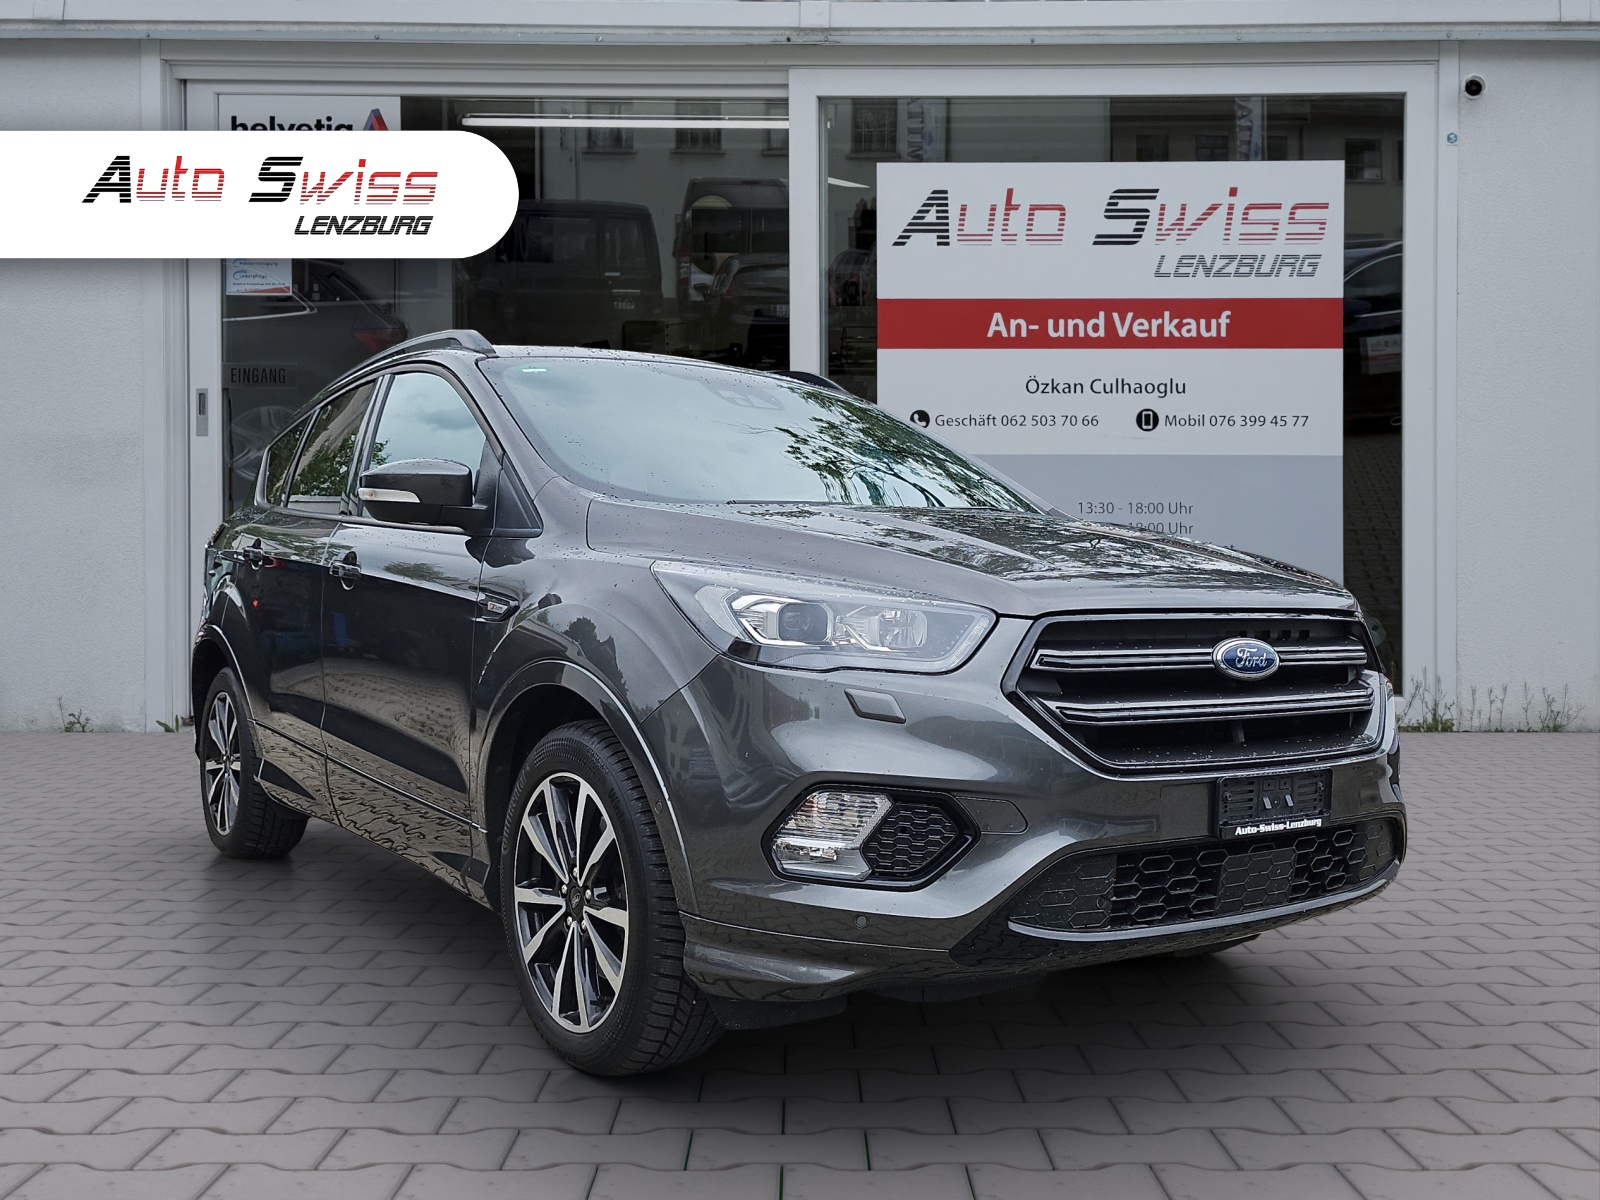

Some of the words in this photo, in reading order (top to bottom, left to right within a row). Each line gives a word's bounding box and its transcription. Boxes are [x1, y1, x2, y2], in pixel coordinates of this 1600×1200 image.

[891, 187, 1067, 246] Auto
[1092, 187, 1329, 246] Swiss
[1154, 254, 1322, 278] LENZBURG
[987, 312, 1040, 338] An-
[1047, 311, 1106, 338] und
[1112, 311, 1232, 338] Verkauf
[230, 367, 286, 384] EINGANG
[1025, 374, 1084, 395] Özkan
[1090, 375, 1186, 399] Culhaoglu
[935, 412, 998, 427] Geschäft
[1001, 413, 1027, 427] 062
[1031, 413, 1057, 427] 503
[1061, 413, 1078, 427] 70
[1082, 413, 1099, 427] 66
[1165, 413, 1206, 427] Mobil
[1209, 413, 1236, 427] 076
[1240, 413, 1267, 427] 399
[1270, 413, 1288, 427] 45
[1291, 413, 1309, 427] 77
[1078, 502, 1115, 515] 13:30
[1128, 502, 1165, 515] 18:00
[1168, 502, 1194, 515] Uhr
[1128, 522, 1165, 534] :00
[1168, 522, 1194, 534] Uhr
[1235, 647, 1268, 668] Ford
[1235, 818, 1322, 836] Auto-Swiss-Lenzburg
